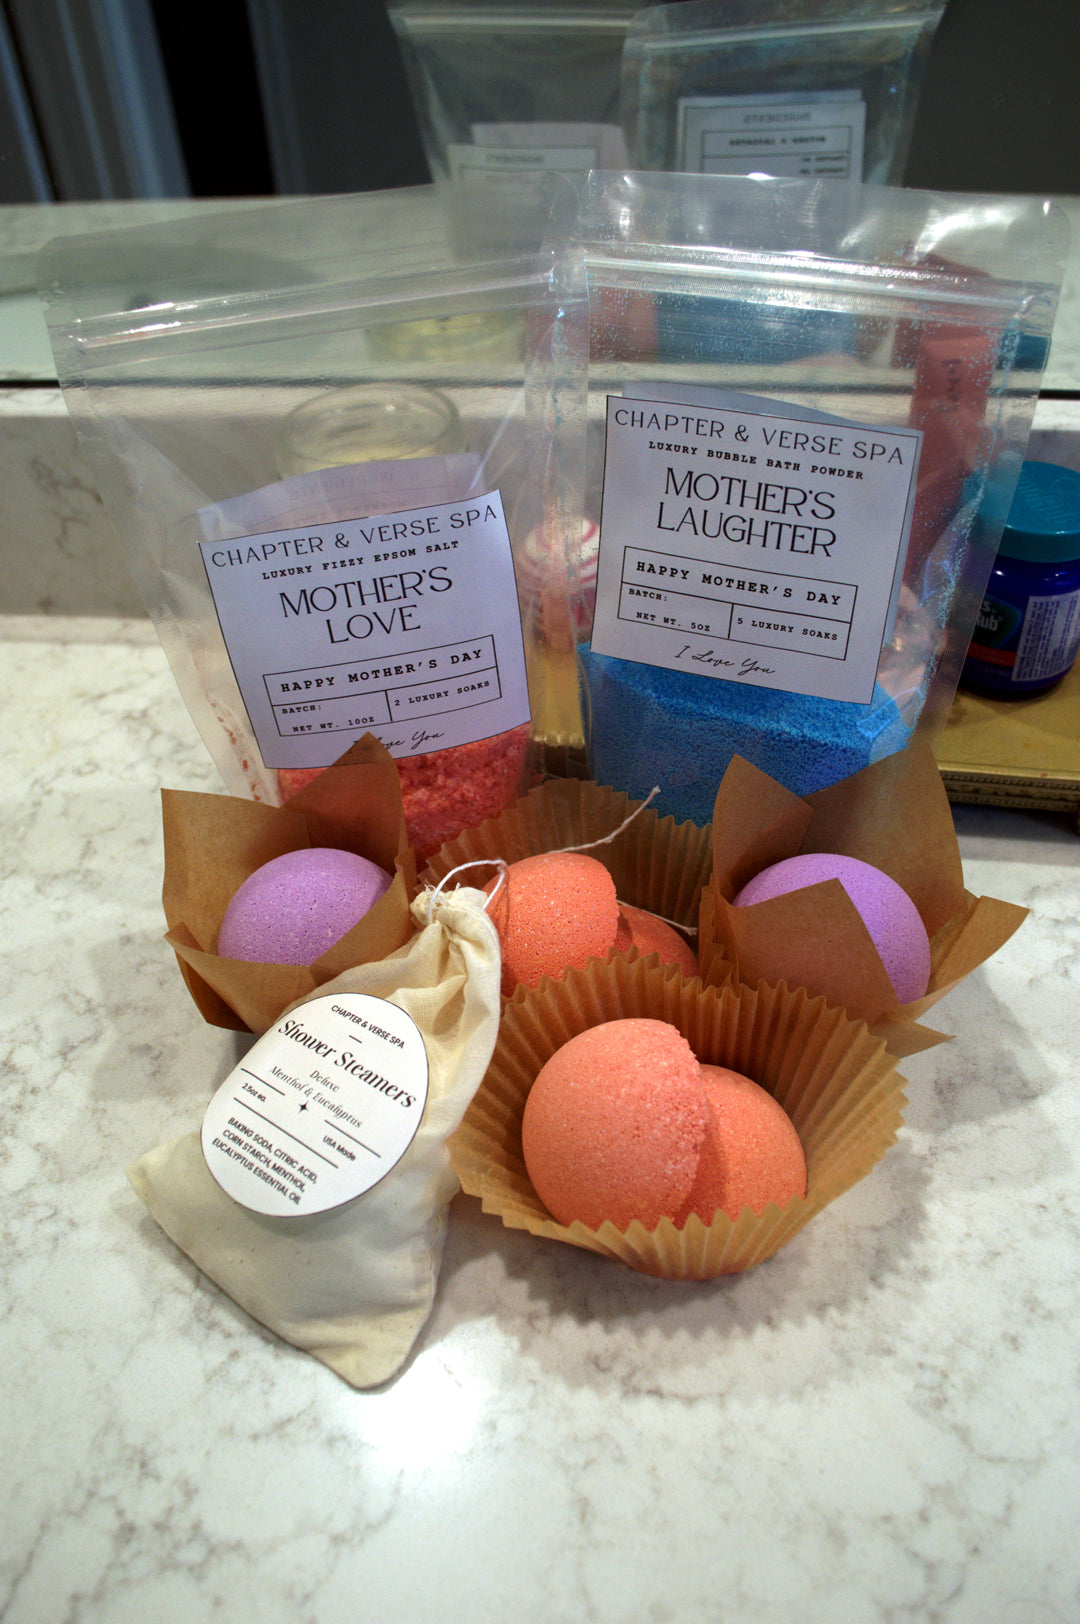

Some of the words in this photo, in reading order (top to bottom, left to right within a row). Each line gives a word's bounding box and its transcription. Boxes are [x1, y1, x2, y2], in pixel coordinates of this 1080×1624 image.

[615, 409, 725, 439] CHAPTER
[735, 425, 749, 442] &
[763, 428, 842, 455] VERSE
[852, 442, 903, 464] SPA
[648, 441, 697, 455] LUXURY
[707, 449, 757, 464] BUBBLE
[767, 458, 800, 471] BATH
[811, 465, 863, 480] POWDER
[664, 468, 835, 519] MOTHER'S
[211, 536, 324, 568] CHAPTER
[335, 533, 349, 548] &
[360, 517, 440, 544] VERSE
[450, 505, 497, 528] SPA
[657, 502, 836, 557] LAUGHTER
[262, 565, 312, 580] LUXURY
[323, 557, 364, 570] FIZZY
[374, 548, 416, 562] EPSOM
[426, 541, 460, 553] SALT
[280, 566, 453, 617] MOTHER'S
[629, 588, 668, 602] BATCH:
[636, 561, 690, 580] HAPPY
[702, 573, 793, 598] MOTHER'S
[807, 591, 841, 605] DAY
[326, 605, 421, 644] LOVE
[636, 612, 656, 622] NET
[663, 617, 682, 627] WT.
[752, 620, 794, 633] LUXURY
[802, 628, 838, 640] SOAKS
[281, 676, 335, 692] HAPPY
[349, 659, 438, 683] MOTHER'S
[450, 650, 483, 664] DAY
[674, 646, 690, 659] I
[692, 651, 735, 667] Love
[741, 658, 776, 675] You
[282, 704, 322, 714] BATCH:
[409, 690, 449, 704] LUXURY
[457, 681, 490, 694] SOAKS
[410, 730, 445, 749] You
[331, 1005, 362, 1025] CHAPTER
[360, 1020, 368, 1028] &
[369, 1024, 390, 1041] VERSE
[389, 1036, 405, 1049] SPA
[278, 1020, 336, 1058] Shower
[334, 1052, 417, 1108] Steamers
[309, 1069, 340, 1093] Deluxe
[242, 1082, 258, 1098] 2.5oz
[256, 1093, 266, 1103] ea.
[269, 1066, 305, 1092] Menthol
[304, 1086, 312, 1097] &
[312, 1092, 364, 1129] Eucalyptus
[222, 1130, 242, 1146] CORN
[241, 1143, 271, 1168] STARCH,
[270, 1162, 306, 1192] MENTHOL,
[227, 1117, 254, 1138] BAKING
[252, 1133, 273, 1152] SODA,
[273, 1148, 298, 1168] CITRIC
[297, 1165, 318, 1184] ACID,
[323, 1136, 338, 1149] USA
[336, 1144, 356, 1161] Made
[212, 1138, 254, 1171] EUCALYPTUS
[253, 1167, 290, 1197] ESSENTIAL
[288, 1192, 302, 1205] OIL
